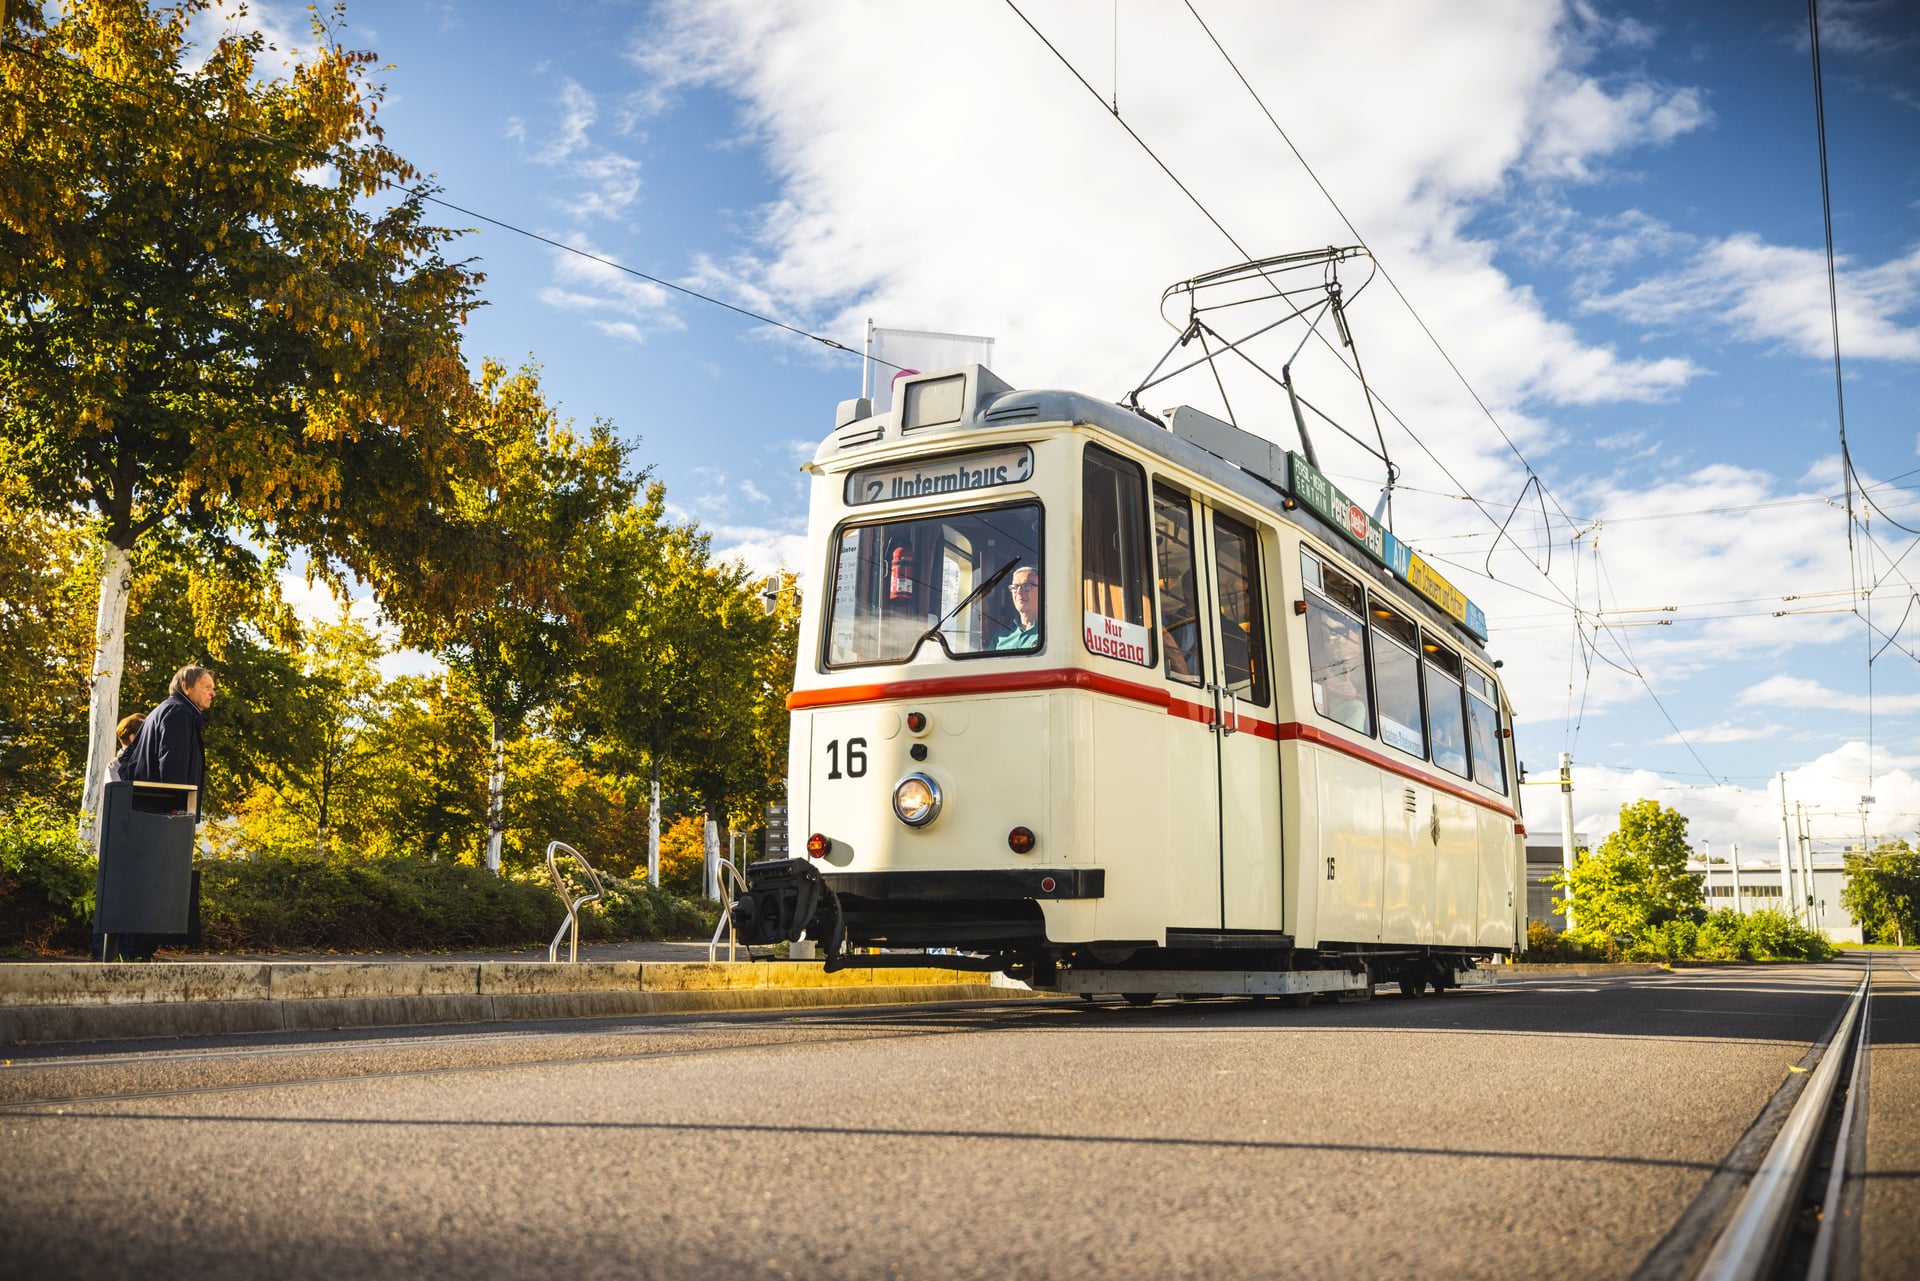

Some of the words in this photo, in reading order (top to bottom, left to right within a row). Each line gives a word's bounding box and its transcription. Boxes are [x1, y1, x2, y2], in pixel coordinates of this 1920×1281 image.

[867, 480, 884, 501] 2
[1296, 475, 1327, 512] GENTHIN
[1330, 485, 1350, 532] Persil
[1365, 514, 1383, 558] Persil
[1393, 539, 1407, 577] ATA
[1411, 564, 1421, 589] zum
[1086, 626, 1144, 665] Ausgang
[1104, 618, 1123, 638] Nur
[826, 737, 868, 780] 16
[1327, 856, 1335, 881] 16
